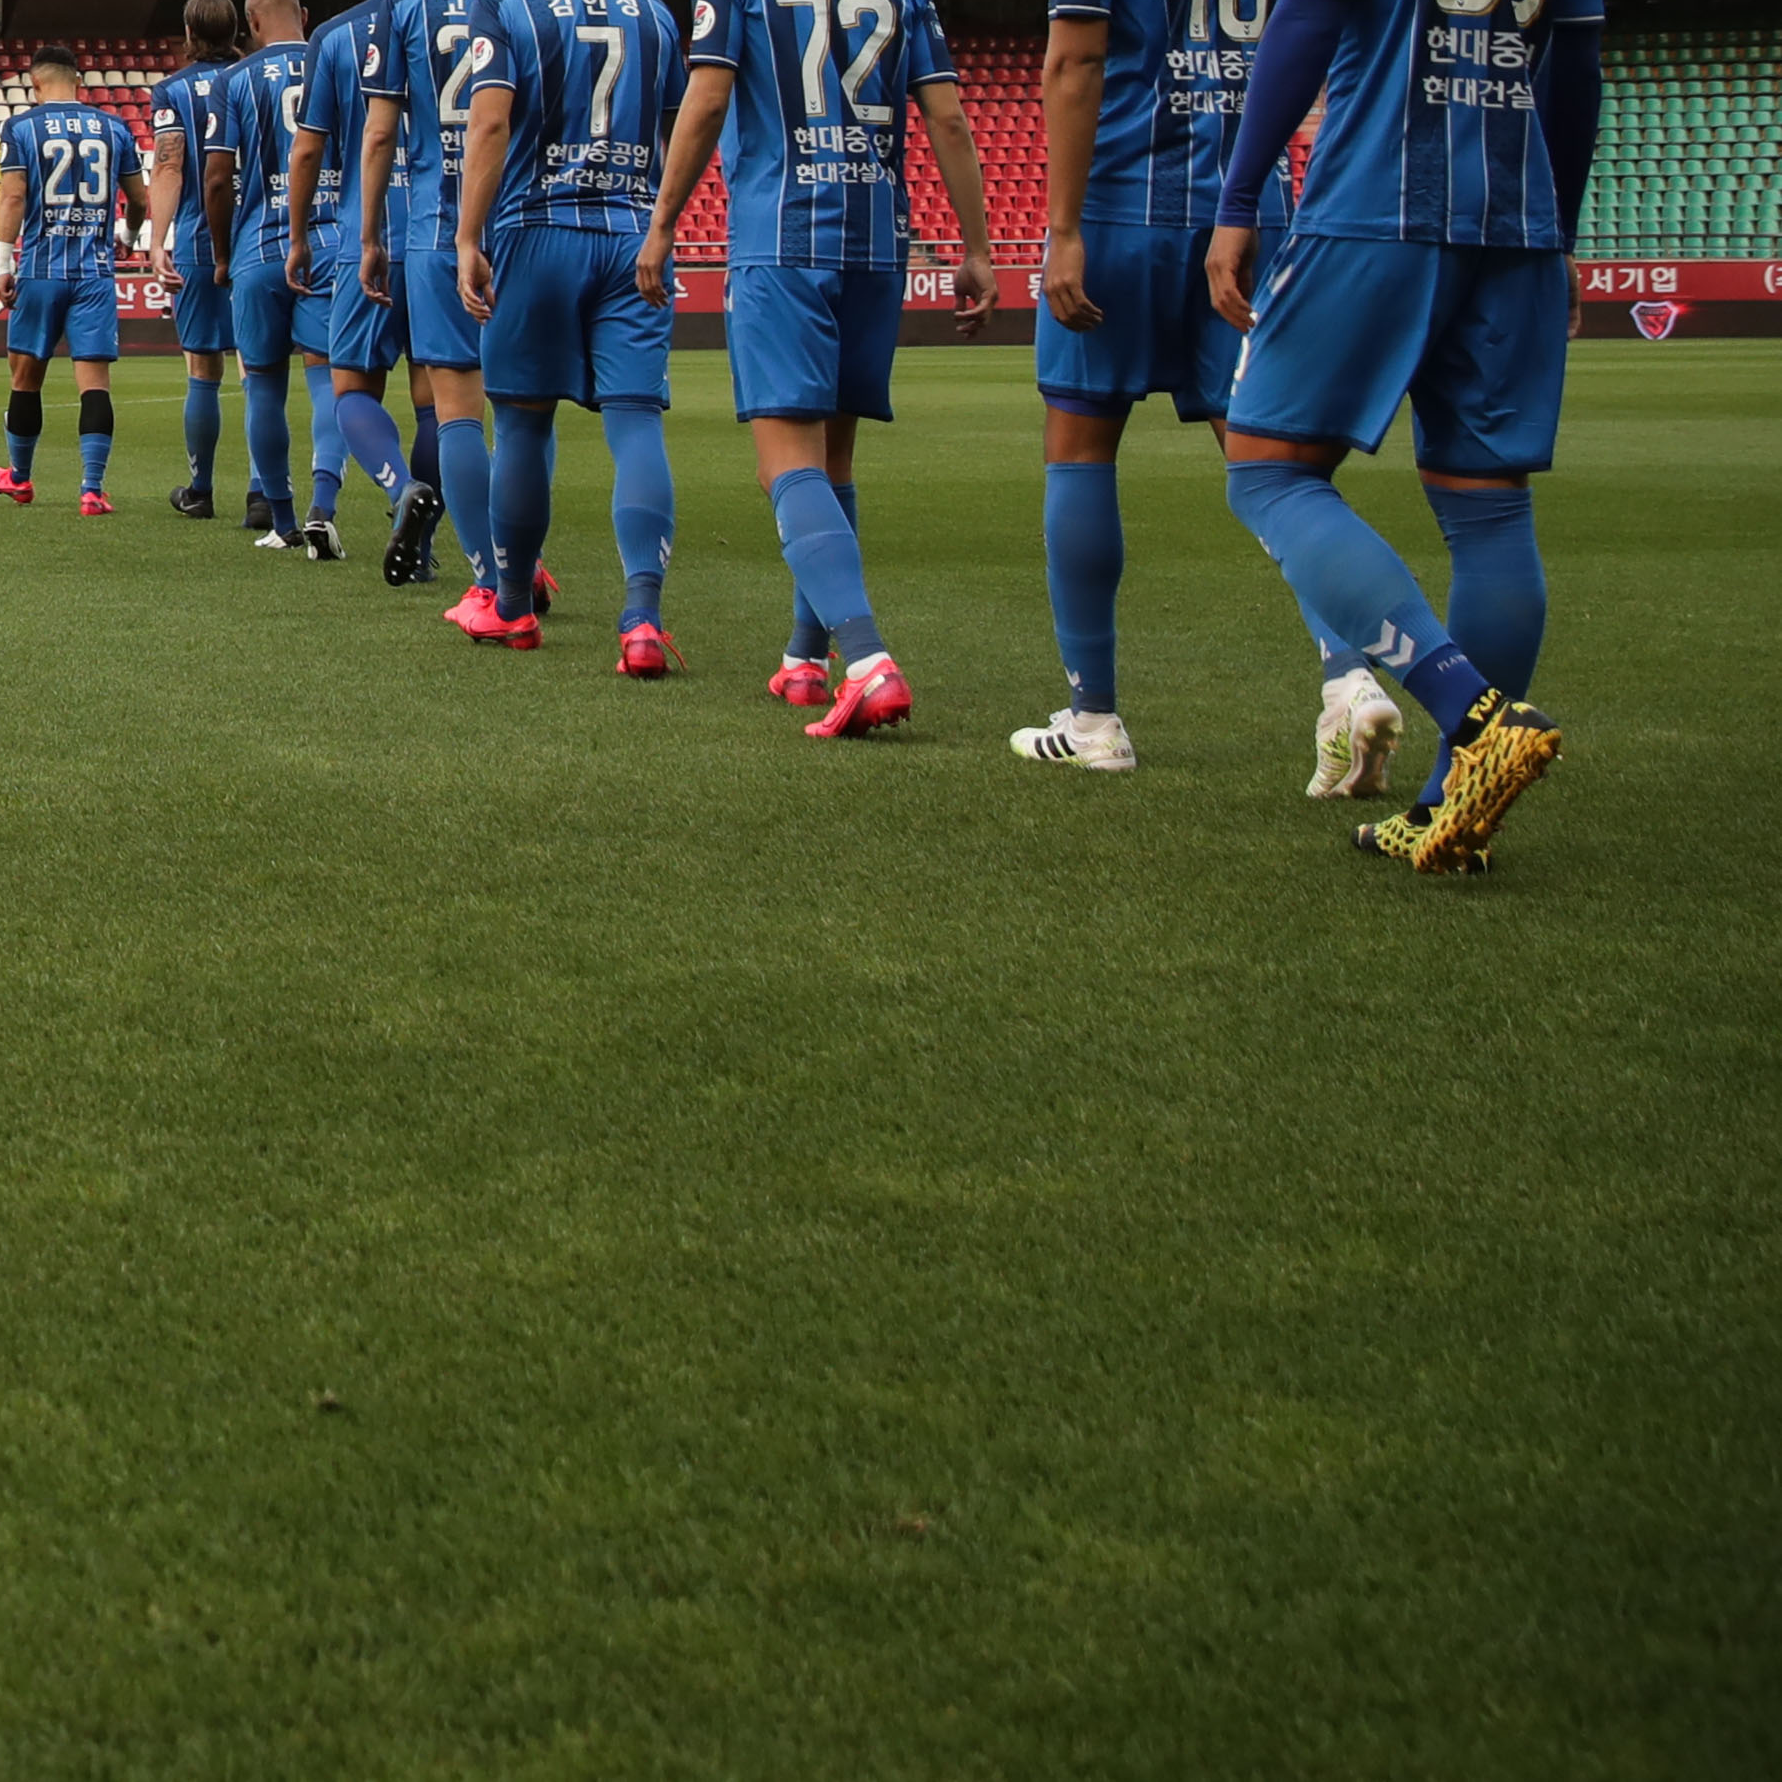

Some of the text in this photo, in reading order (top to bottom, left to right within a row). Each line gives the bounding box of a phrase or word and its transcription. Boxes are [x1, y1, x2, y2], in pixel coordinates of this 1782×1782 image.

[575, 26, 625, 138] 7
[44, 118, 103, 134] 김태환
[546, 141, 650, 168] 현대중공업
[793, 125, 895, 158] 현대중업
[42, 138, 109, 205] 23
[1583, 267, 1678, 293] 서기업
